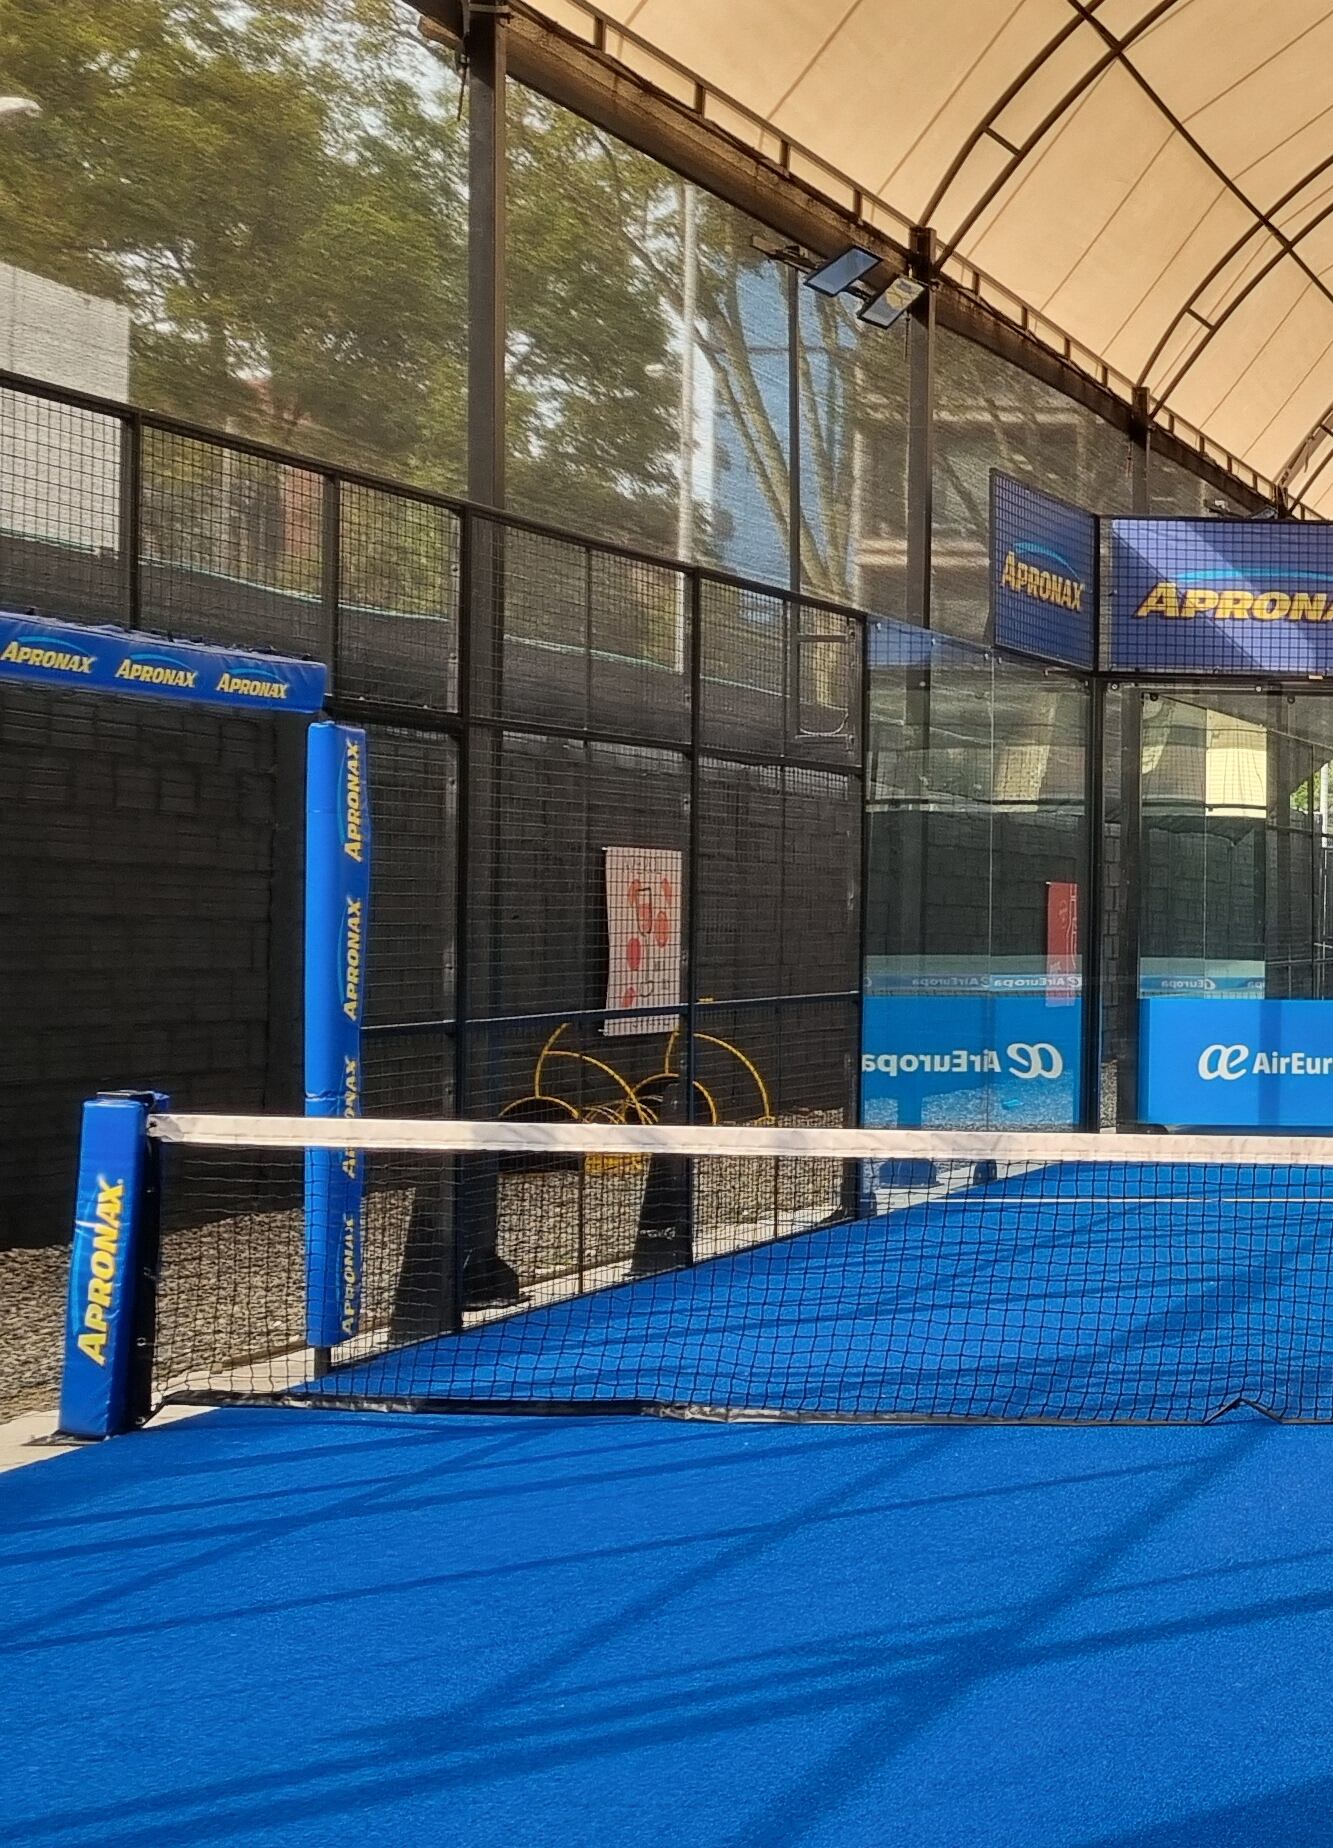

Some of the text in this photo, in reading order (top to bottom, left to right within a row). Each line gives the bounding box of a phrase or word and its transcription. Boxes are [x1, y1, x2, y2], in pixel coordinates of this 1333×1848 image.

[1000, 550, 1085, 612] APRONAX
[1, 640, 97, 674] APRONAX
[115, 658, 198, 688] APRONAX
[216, 673, 289, 700] APRONAX
[344, 739, 362, 862] APRONAX
[343, 896, 361, 1022] APRONAX
[342, 1055, 357, 1179] APONAX
[77, 1177, 124, 1367] APRONAX
